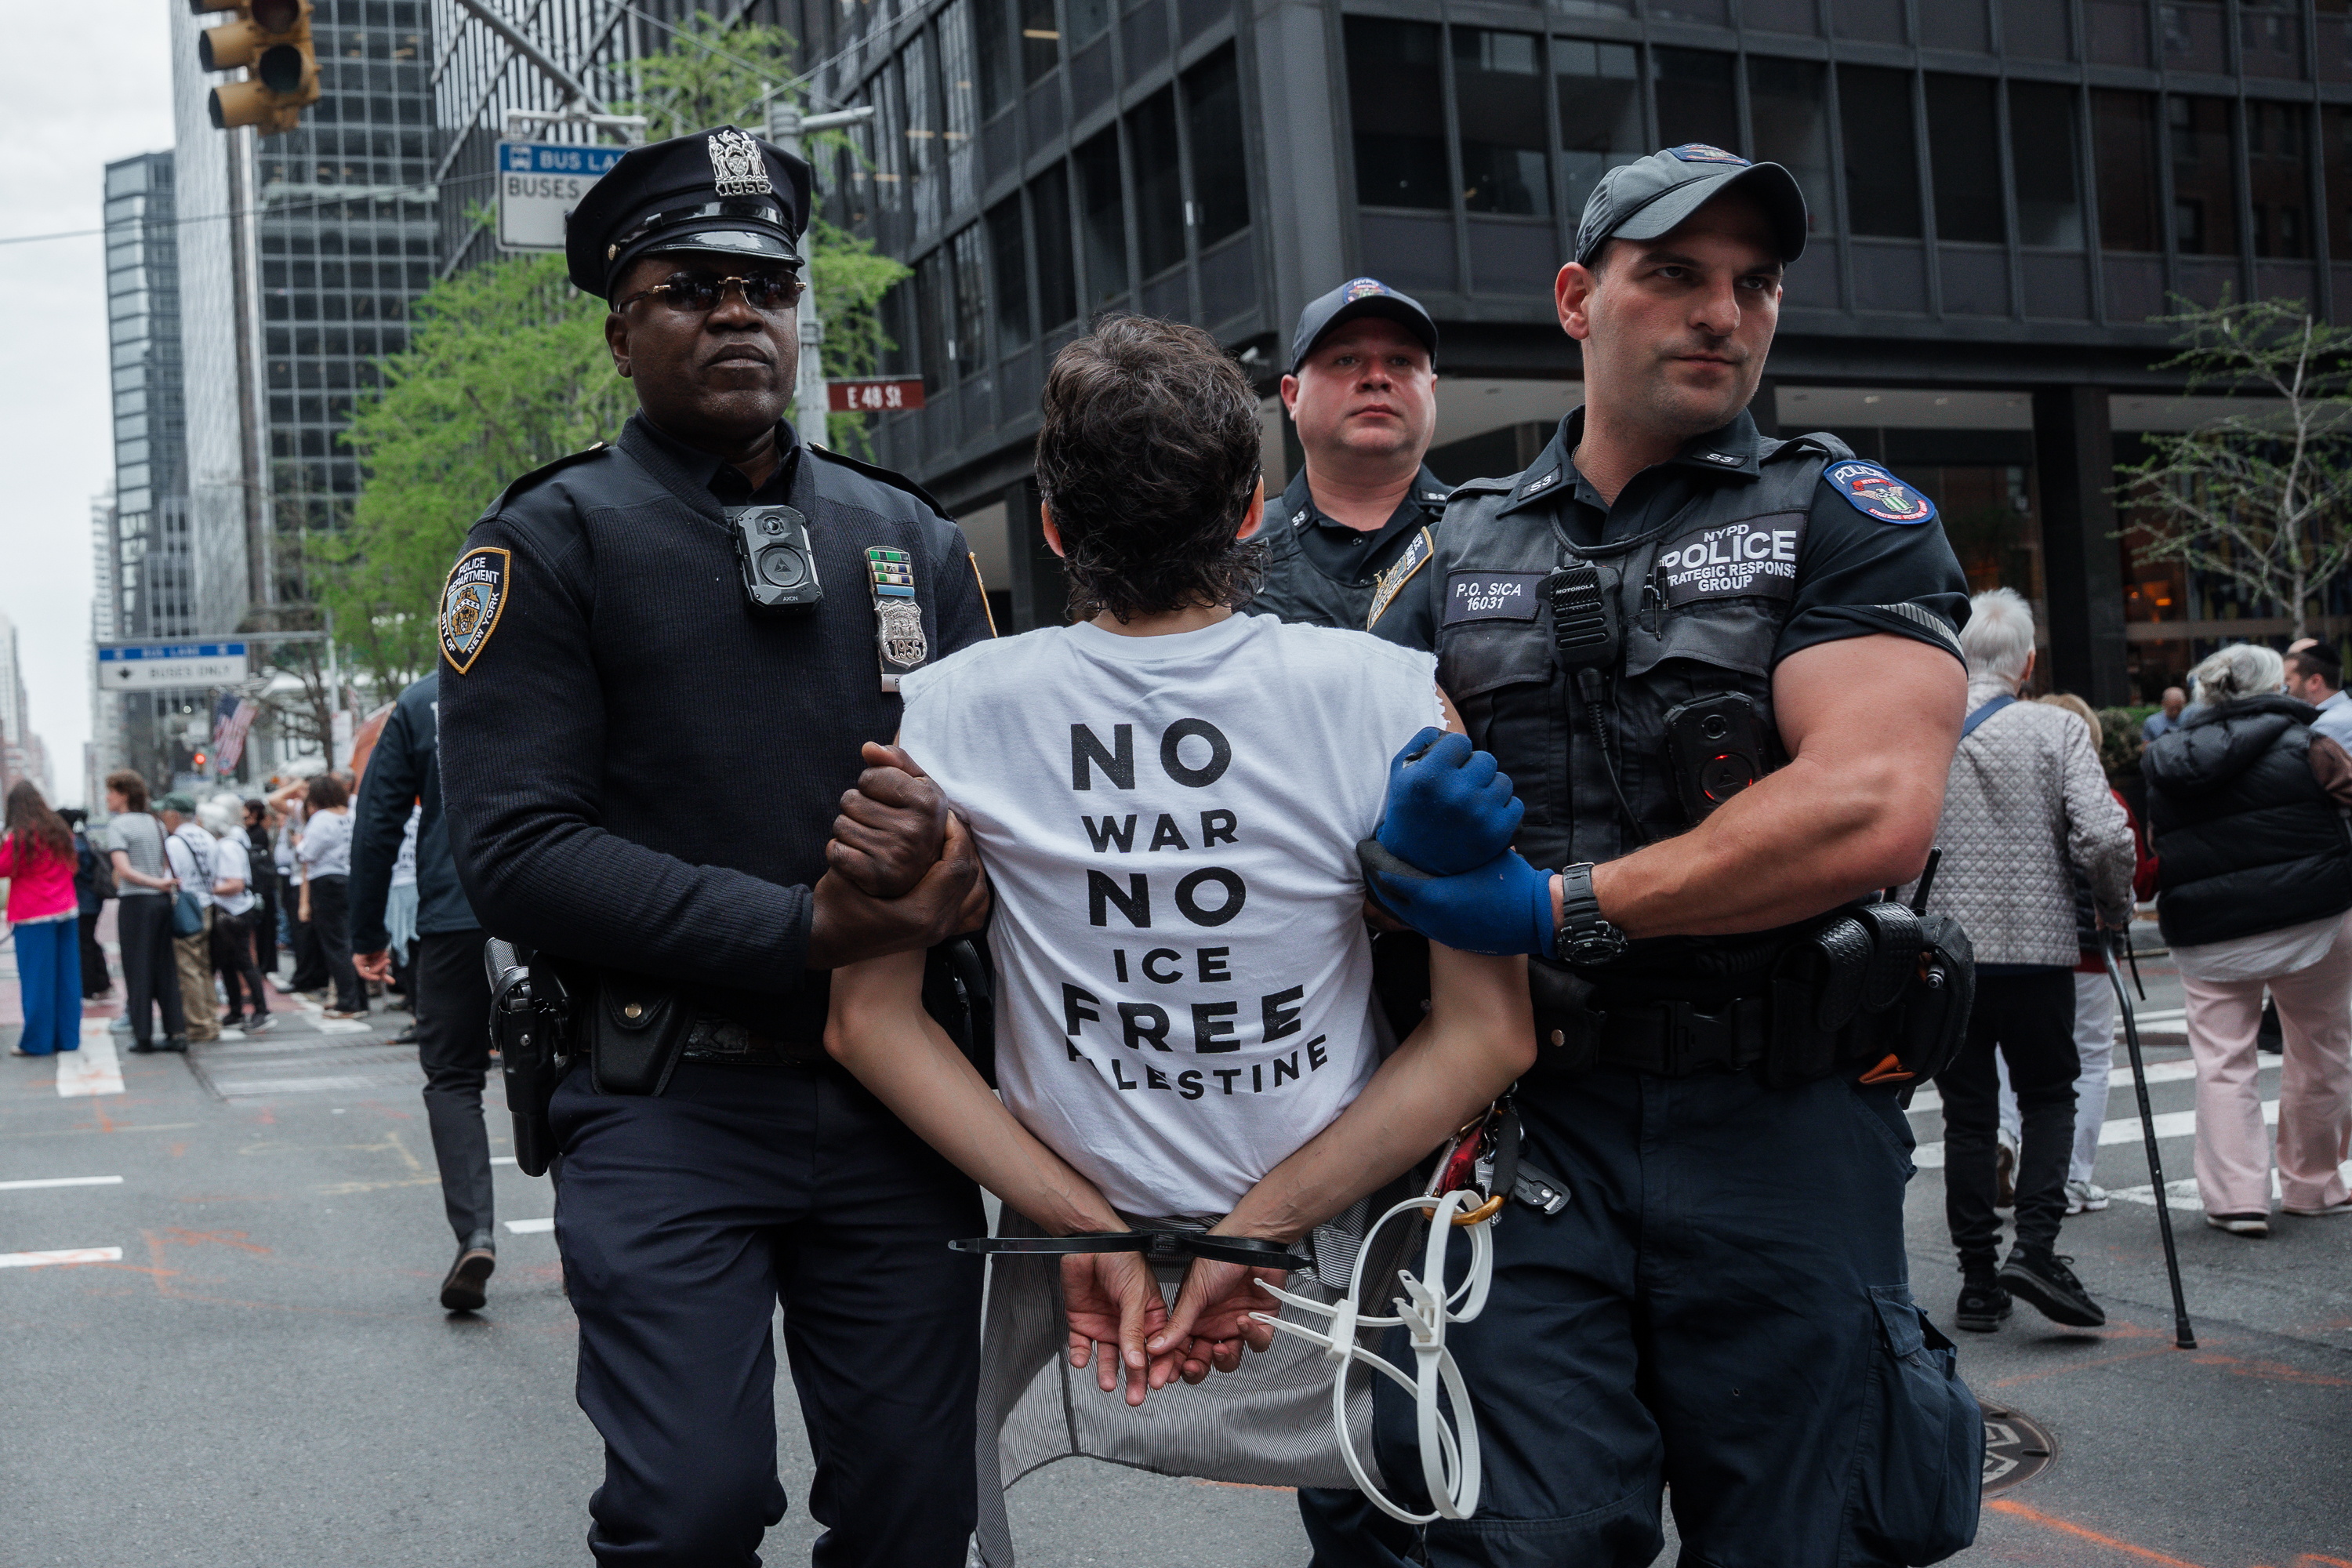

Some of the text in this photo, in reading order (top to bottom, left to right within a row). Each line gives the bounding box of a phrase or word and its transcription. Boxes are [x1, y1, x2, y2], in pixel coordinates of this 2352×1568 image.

[539, 150, 624, 172] BUS LA
[508, 176, 580, 199] BUSES
[724, 180, 770, 195] 1956
[847, 386, 859, 408] E
[1530, 475, 1552, 492] S3
[1834, 465, 1890, 485] POLICE
[1704, 524, 1749, 543] NYPD
[1661, 528, 1797, 568] POLICE
[458, 557, 487, 578] POLICE
[1668, 561, 1797, 587] RATEGIC RESPONSE
[447, 569, 499, 597] DEPARTMENT
[1455, 583, 1521, 597] P.O. SICA
[1555, 583, 1595, 594] MOTOROLA
[1698, 575, 1753, 592] GROUP
[1467, 597, 1504, 611] 16031
[441, 612, 457, 652] CITY OF
[466, 592, 499, 655] NEW YORK
[891, 639, 922, 660] 1956
[1070, 717, 1232, 791] NO
[1080, 808, 1240, 853] WAR
[1087, 866, 1246, 928] NO
[1113, 946, 1232, 985] ICE
[1062, 982, 1305, 1054] FREE
[1065, 1033, 1328, 1100] PLESTINE
